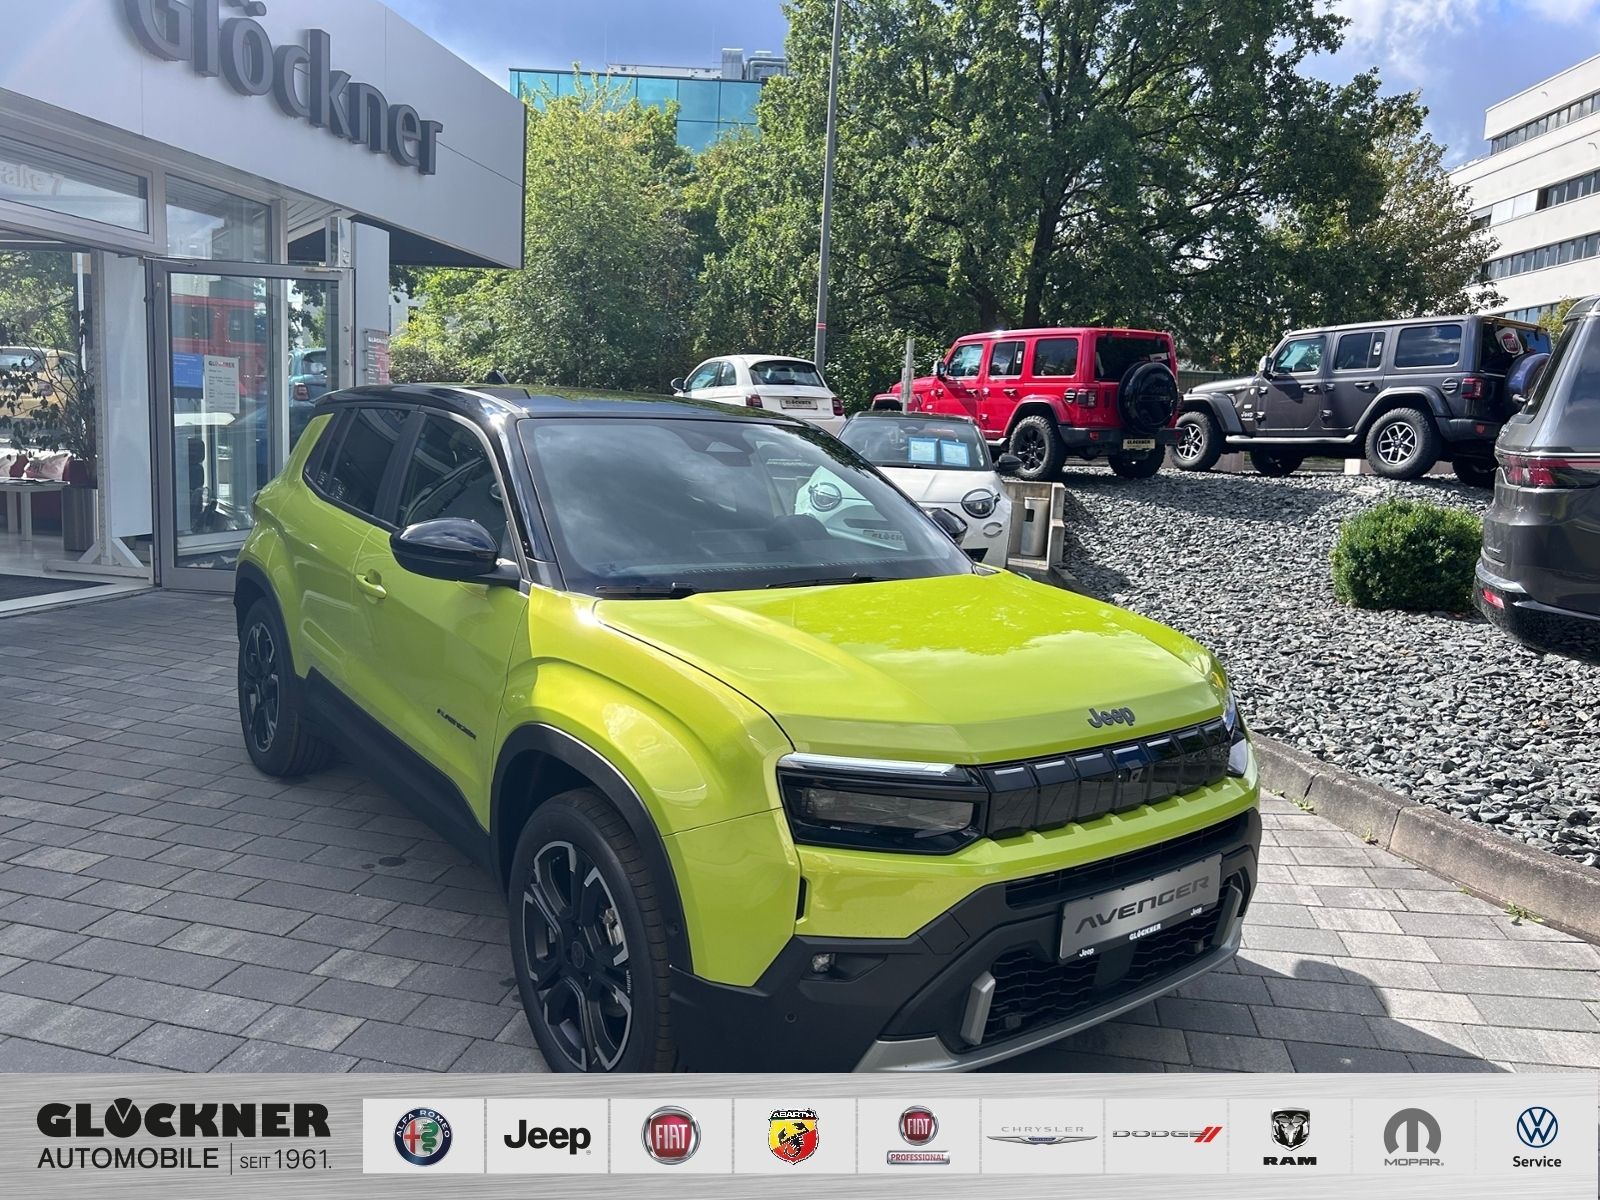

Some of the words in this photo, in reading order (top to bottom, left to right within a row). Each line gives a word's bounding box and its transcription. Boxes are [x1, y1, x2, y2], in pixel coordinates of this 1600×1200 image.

[1087, 708, 1136, 728] Jeep
[1075, 876, 1209, 934] AVENGER
[1190, 906, 1203, 916] Jeep
[1129, 923, 1162, 941] GLÖCKNER
[1079, 947, 1095, 957] Jeep
